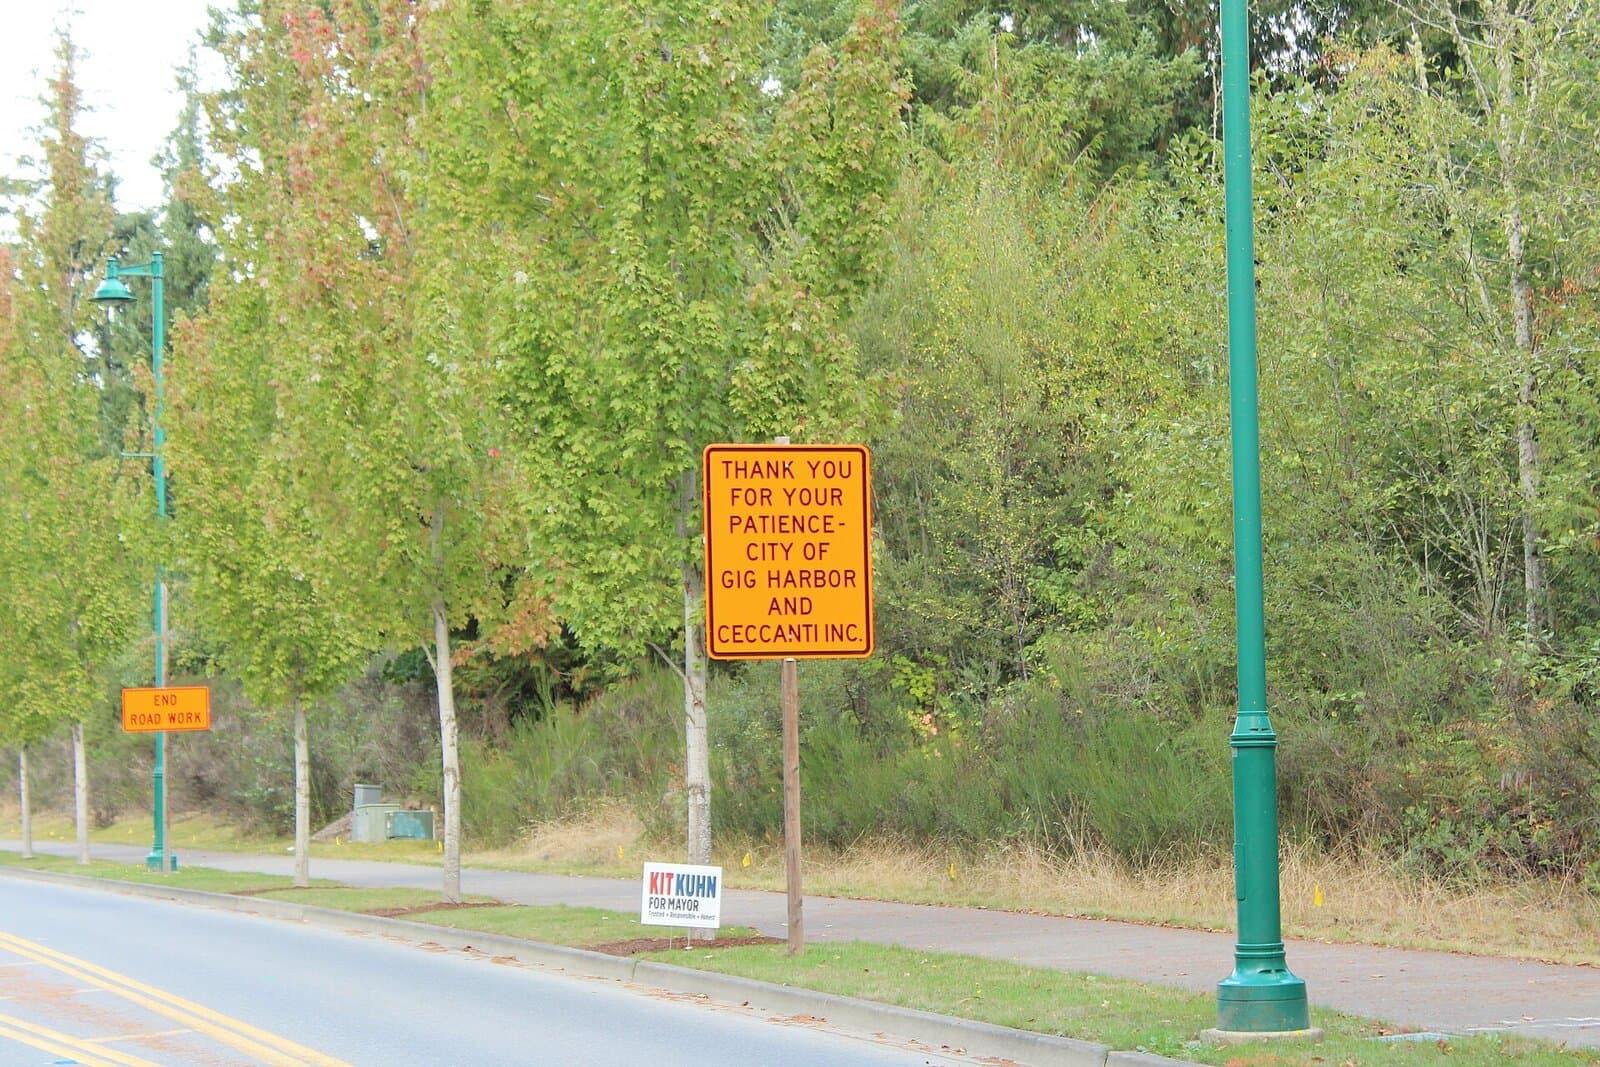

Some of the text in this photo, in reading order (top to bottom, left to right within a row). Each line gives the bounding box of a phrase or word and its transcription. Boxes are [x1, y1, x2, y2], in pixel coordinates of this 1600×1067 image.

[721, 460, 852, 479] THANK YOU
[731, 487, 843, 506] FOR YOUR
[729, 515, 846, 534] PATIENCE-
[746, 542, 830, 561] CITY OF
[721, 569, 856, 589] GIG HARBOR
[768, 597, 812, 616] AND
[717, 623, 863, 643] CECCANTI INC.
[154, 694, 177, 706] END
[130, 712, 201, 725] ROAD WORK
[649, 871, 717, 898] KIT KUHN
[648, 896, 699, 911] FOR MAYOR
